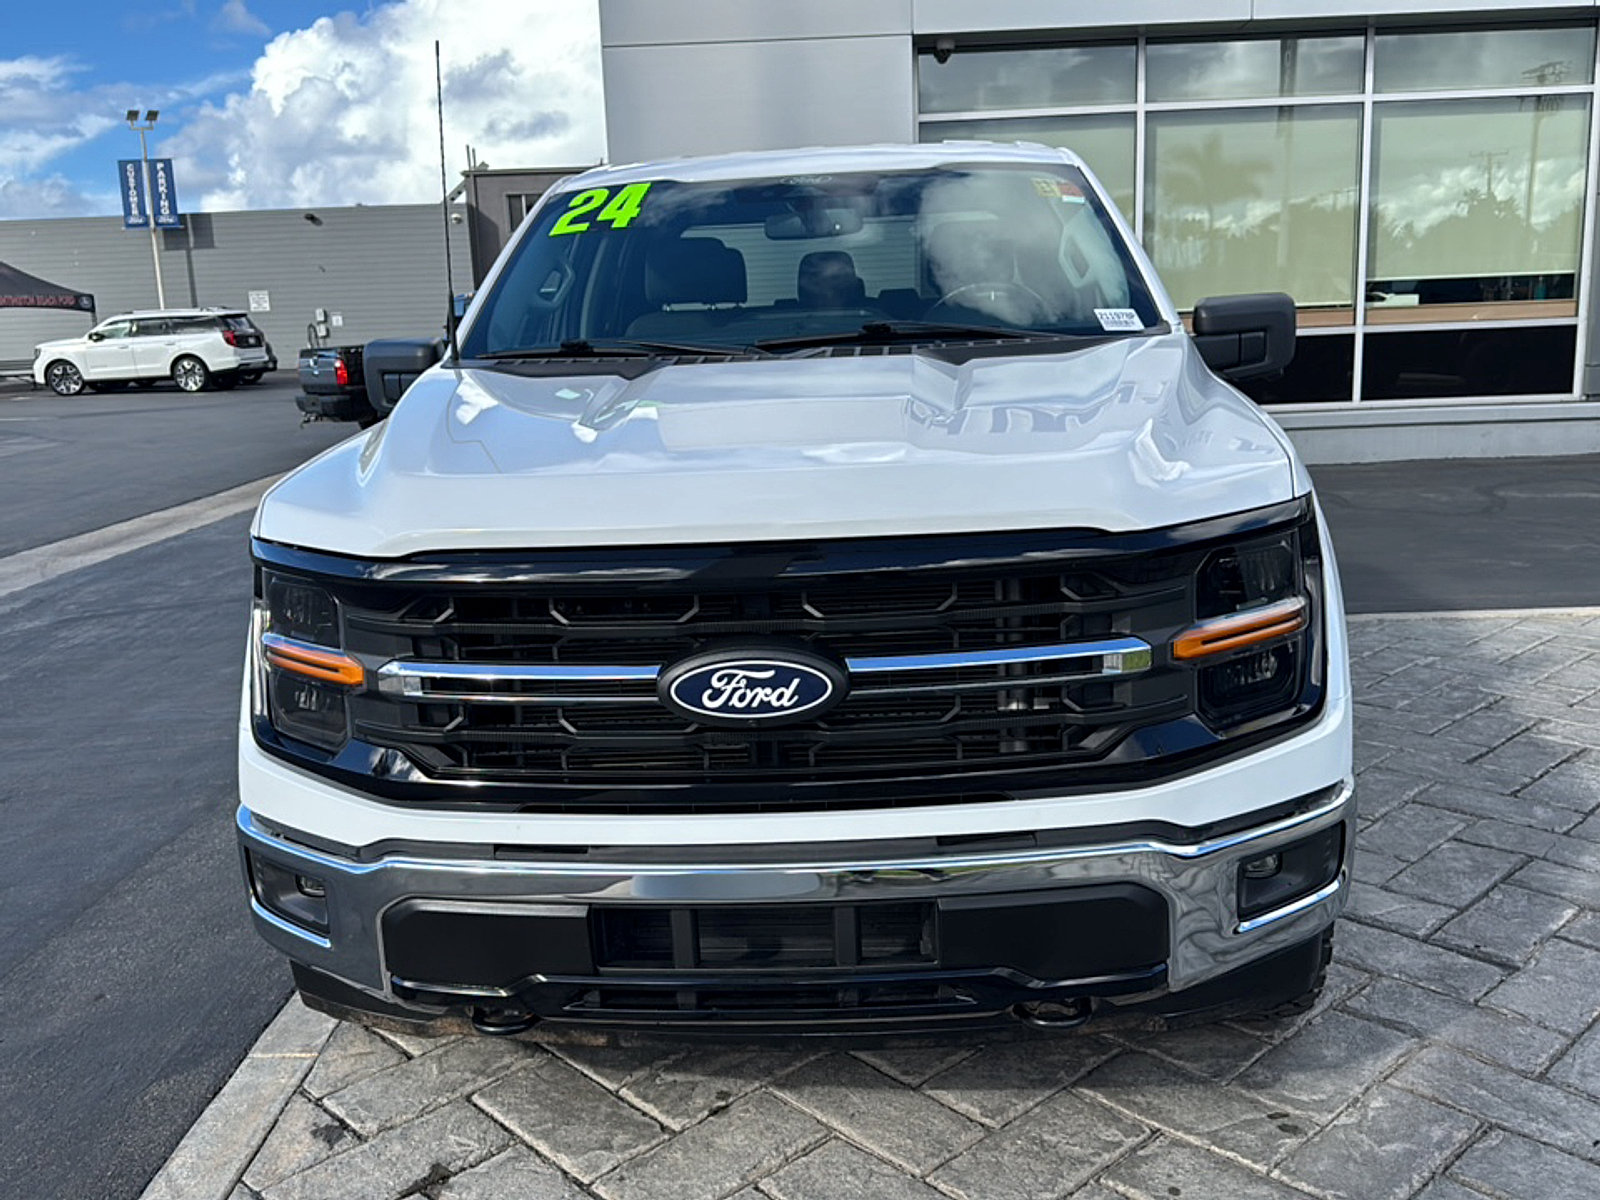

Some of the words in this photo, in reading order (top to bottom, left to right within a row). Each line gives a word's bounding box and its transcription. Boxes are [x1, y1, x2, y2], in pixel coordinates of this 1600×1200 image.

[126, 163, 140, 217] CUSTOMER
[156, 162, 170, 215] PARKING
[548, 182, 652, 236] 24
[701, 668, 801, 709] Ford
